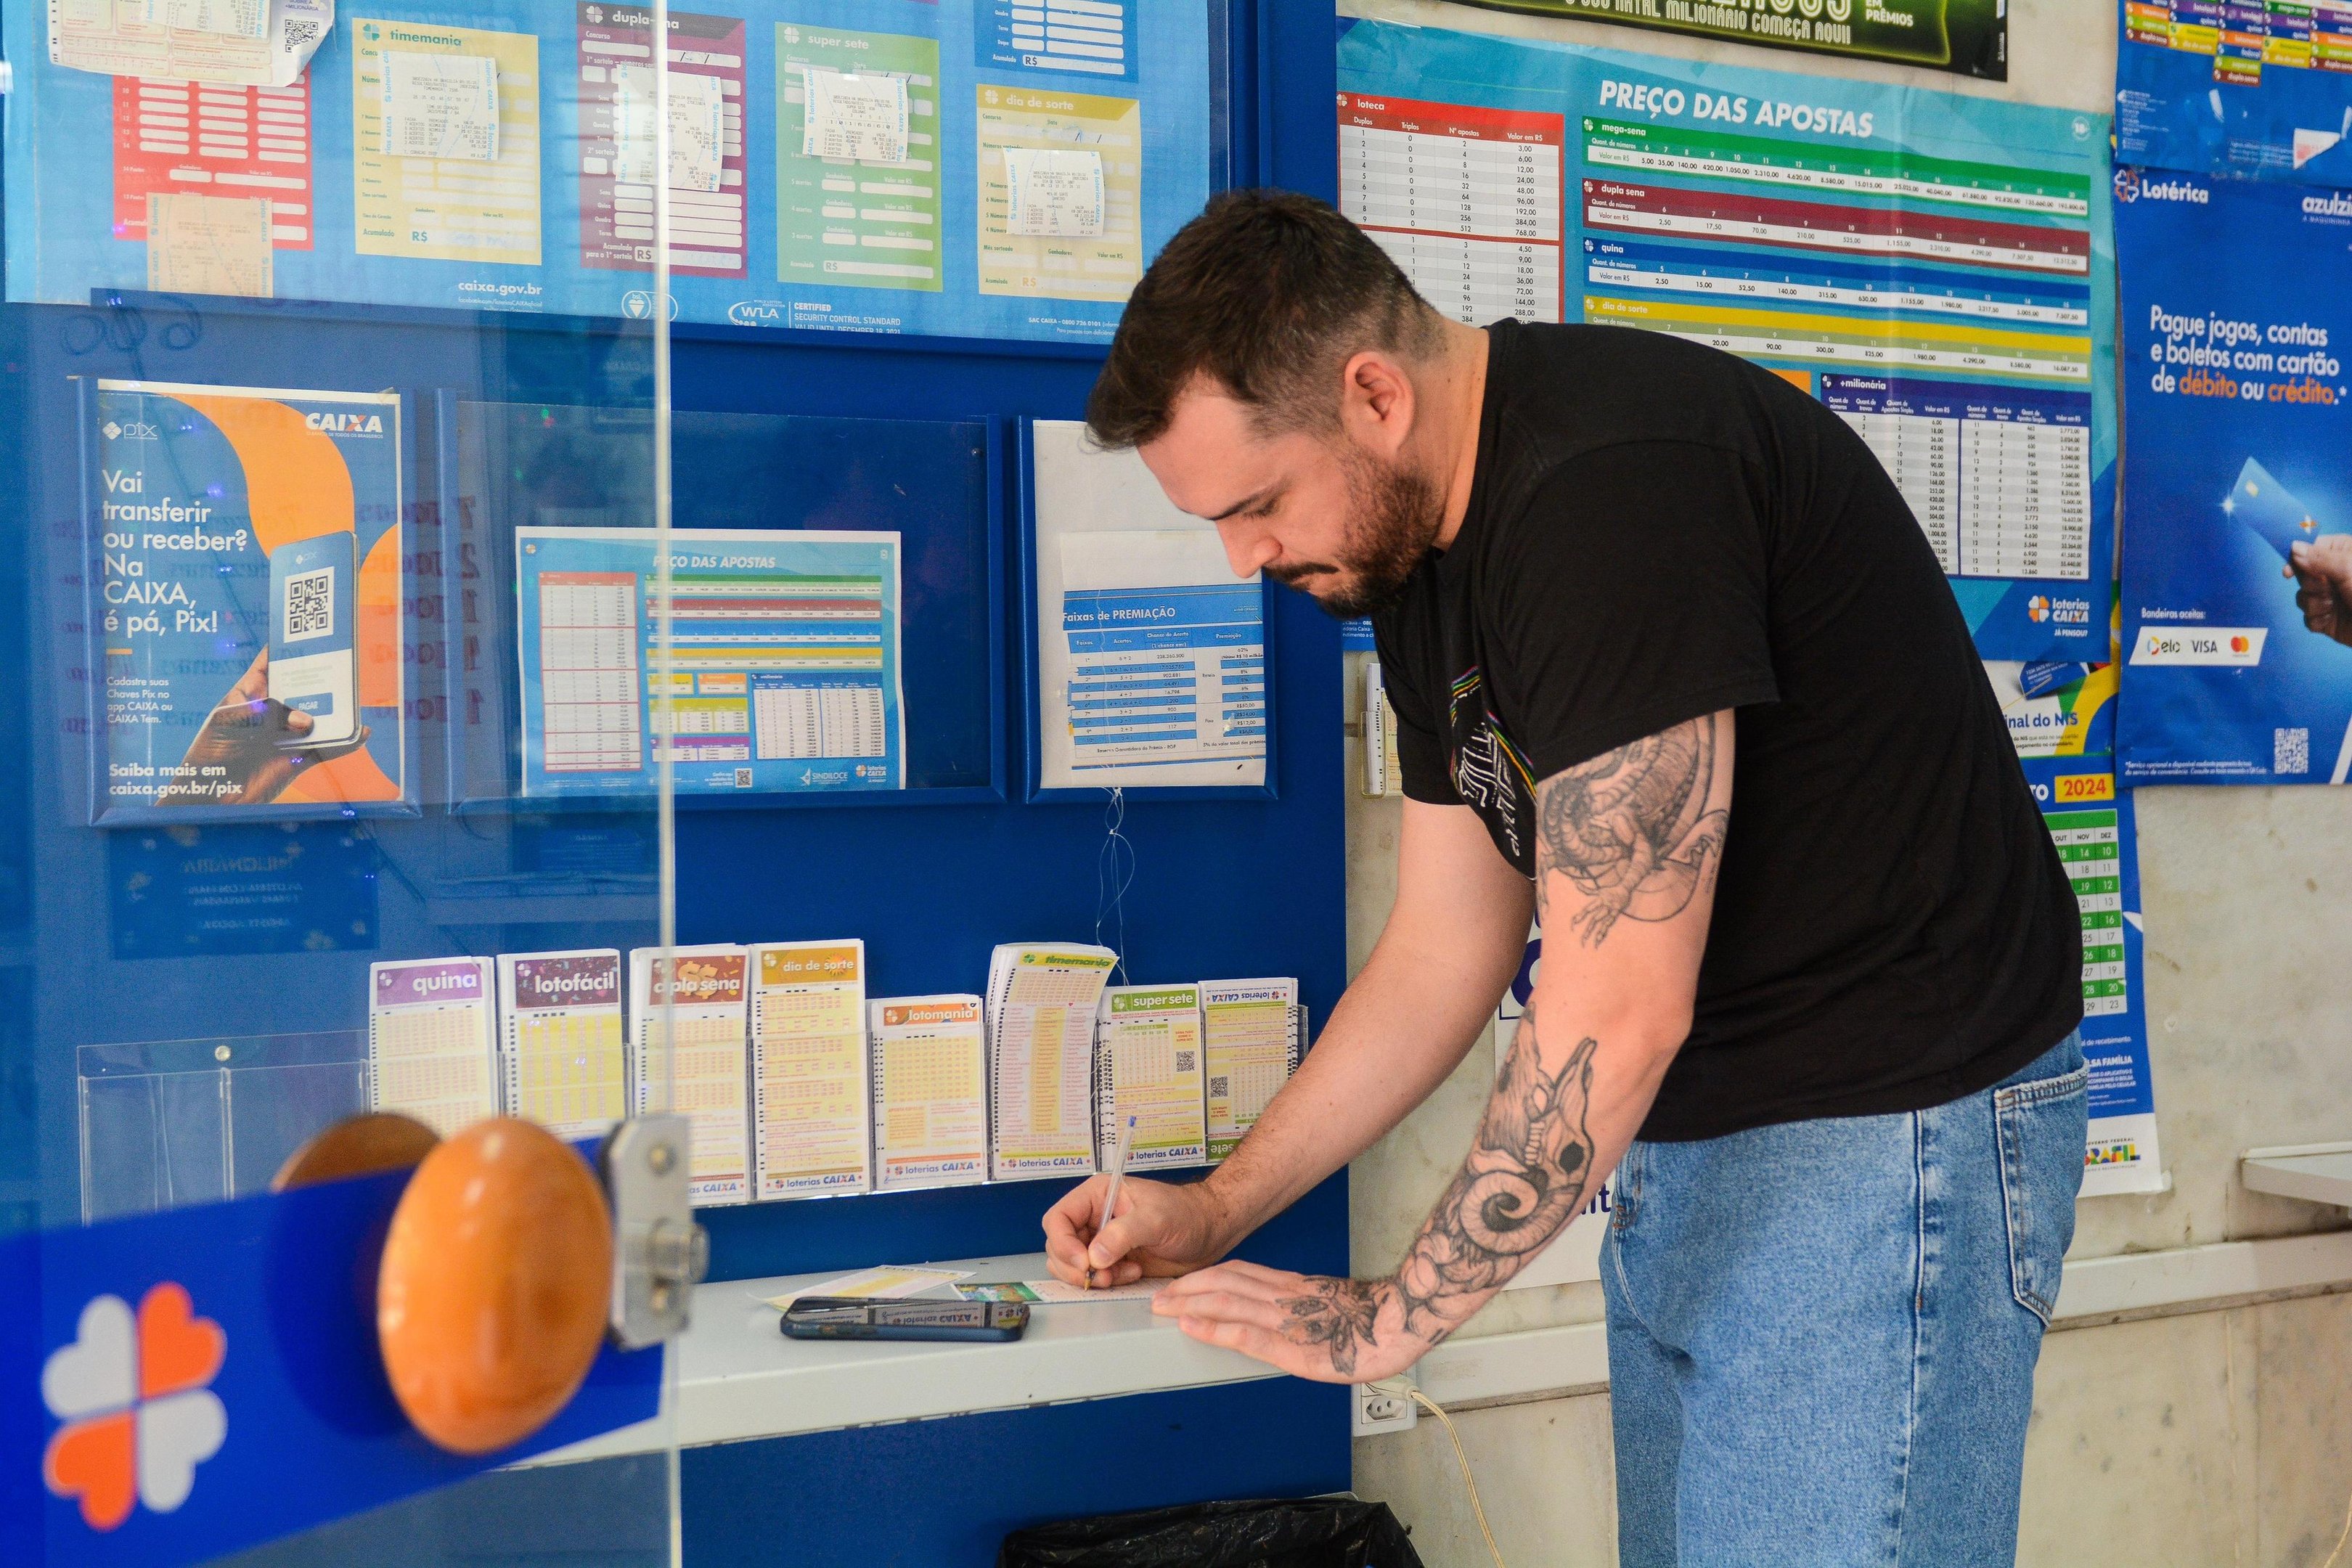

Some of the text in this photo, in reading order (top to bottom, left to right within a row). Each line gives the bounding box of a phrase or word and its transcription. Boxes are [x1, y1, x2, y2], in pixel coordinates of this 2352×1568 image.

[1615, 0, 1661, 17] NATAL
[1667, 1, 1747, 29] MILIONÁRIO
[1752, 13, 1810, 40] COMEÇA
[1865, 8, 1914, 28] PRÊMIOS
[391, 29, 462, 46] timemania
[808, 36, 869, 49] super sete
[1025, 57, 1037, 65] R$
[1006, 95, 1074, 110] dia de sorte
[1357, 99, 1384, 110] loteca
[1600, 80, 1873, 138] PREÇO DAS APOSTAS
[1354, 117, 1373, 126] Duplos
[1402, 122, 1419, 131] Triplos
[1602, 123, 1646, 136] mega-sena
[1658, 159, 1675, 168] 35,00
[1601, 184, 1645, 197] dupla sena
[2142, 179, 2209, 204] Lotérica
[1516, 208, 1537, 216] 192,00
[412, 231, 428, 242] R$
[1516, 229, 1536, 237] 768,00
[637, 250, 652, 260] R$
[1601, 244, 1624, 254] quina
[458, 280, 542, 296] caixa.gov.br
[1022, 277, 1036, 287] R$
[740, 307, 779, 319] WLA
[794, 303, 831, 311] CERTIFIED
[1602, 301, 1648, 314] dia de sorte
[794, 313, 901, 325] SECURITY CONTROL STANDARD
[2151, 304, 2328, 347] Pague jogos, contas
[2151, 335, 2340, 377] e boletos com cartão
[1840, 380, 1886, 390] +milionária
[2152, 364, 2176, 393] de
[2179, 367, 2238, 398] débito
[2241, 381, 2264, 400] ou
[306, 412, 383, 432] CAIXA
[124, 422, 158, 440] pix
[102, 469, 142, 493] Vai
[103, 497, 211, 523] transferir
[104, 526, 248, 552] ou receber?
[105, 552, 143, 576] Na
[691, 556, 717, 568] DAS
[720, 557, 776, 568] APOSTAS
[104, 581, 196, 609] CAIXA,
[2052, 597, 2090, 610] loterias
[1063, 606, 1175, 622] Faixas de PREMIAÇÃO
[2052, 610, 2089, 623] CAIXA
[2141, 608, 2178, 619] Bandeiras
[105, 609, 217, 638] é pá, Pix!
[2161, 639, 2181, 653] elo
[2192, 640, 2218, 653] VISA
[107, 677, 147, 686] Cadastre
[107, 689, 139, 698] Chaves
[142, 690, 155, 698] Pix
[107, 704, 125, 713] app
[127, 701, 159, 711] CAIXA
[107, 714, 162, 723] CAIXA Tem.
[2033, 713, 2051, 727] do
[2055, 712, 2078, 726] NIS
[109, 763, 226, 777] Saiba mais em
[109, 780, 242, 797] caixa.gov.br/pix
[2064, 778, 2106, 797] 2024
[2081, 881, 2112, 891] 19 12
[1045, 955, 1111, 967] timemania
[2084, 949, 2116, 960] 26 18
[783, 959, 854, 972] dia de sorte
[412, 971, 477, 995] quina
[535, 971, 614, 993] lotofácil
[700, 979, 740, 991] sena
[1133, 995, 1193, 1009] super sete
[1212, 992, 1270, 1003] loterias CAIXA
[909, 1008, 973, 1021] lotomania
[2102, 1055, 2133, 1067] FAMÍLIA
[1136, 1147, 1197, 1160] loterias CAIXA
[905, 1161, 974, 1174] loterias CAIXA
[1019, 1157, 1083, 1168] loterias CAIXA
[703, 1182, 737, 1193] CAIXA
[786, 1174, 856, 1188] loterias CAIXA
